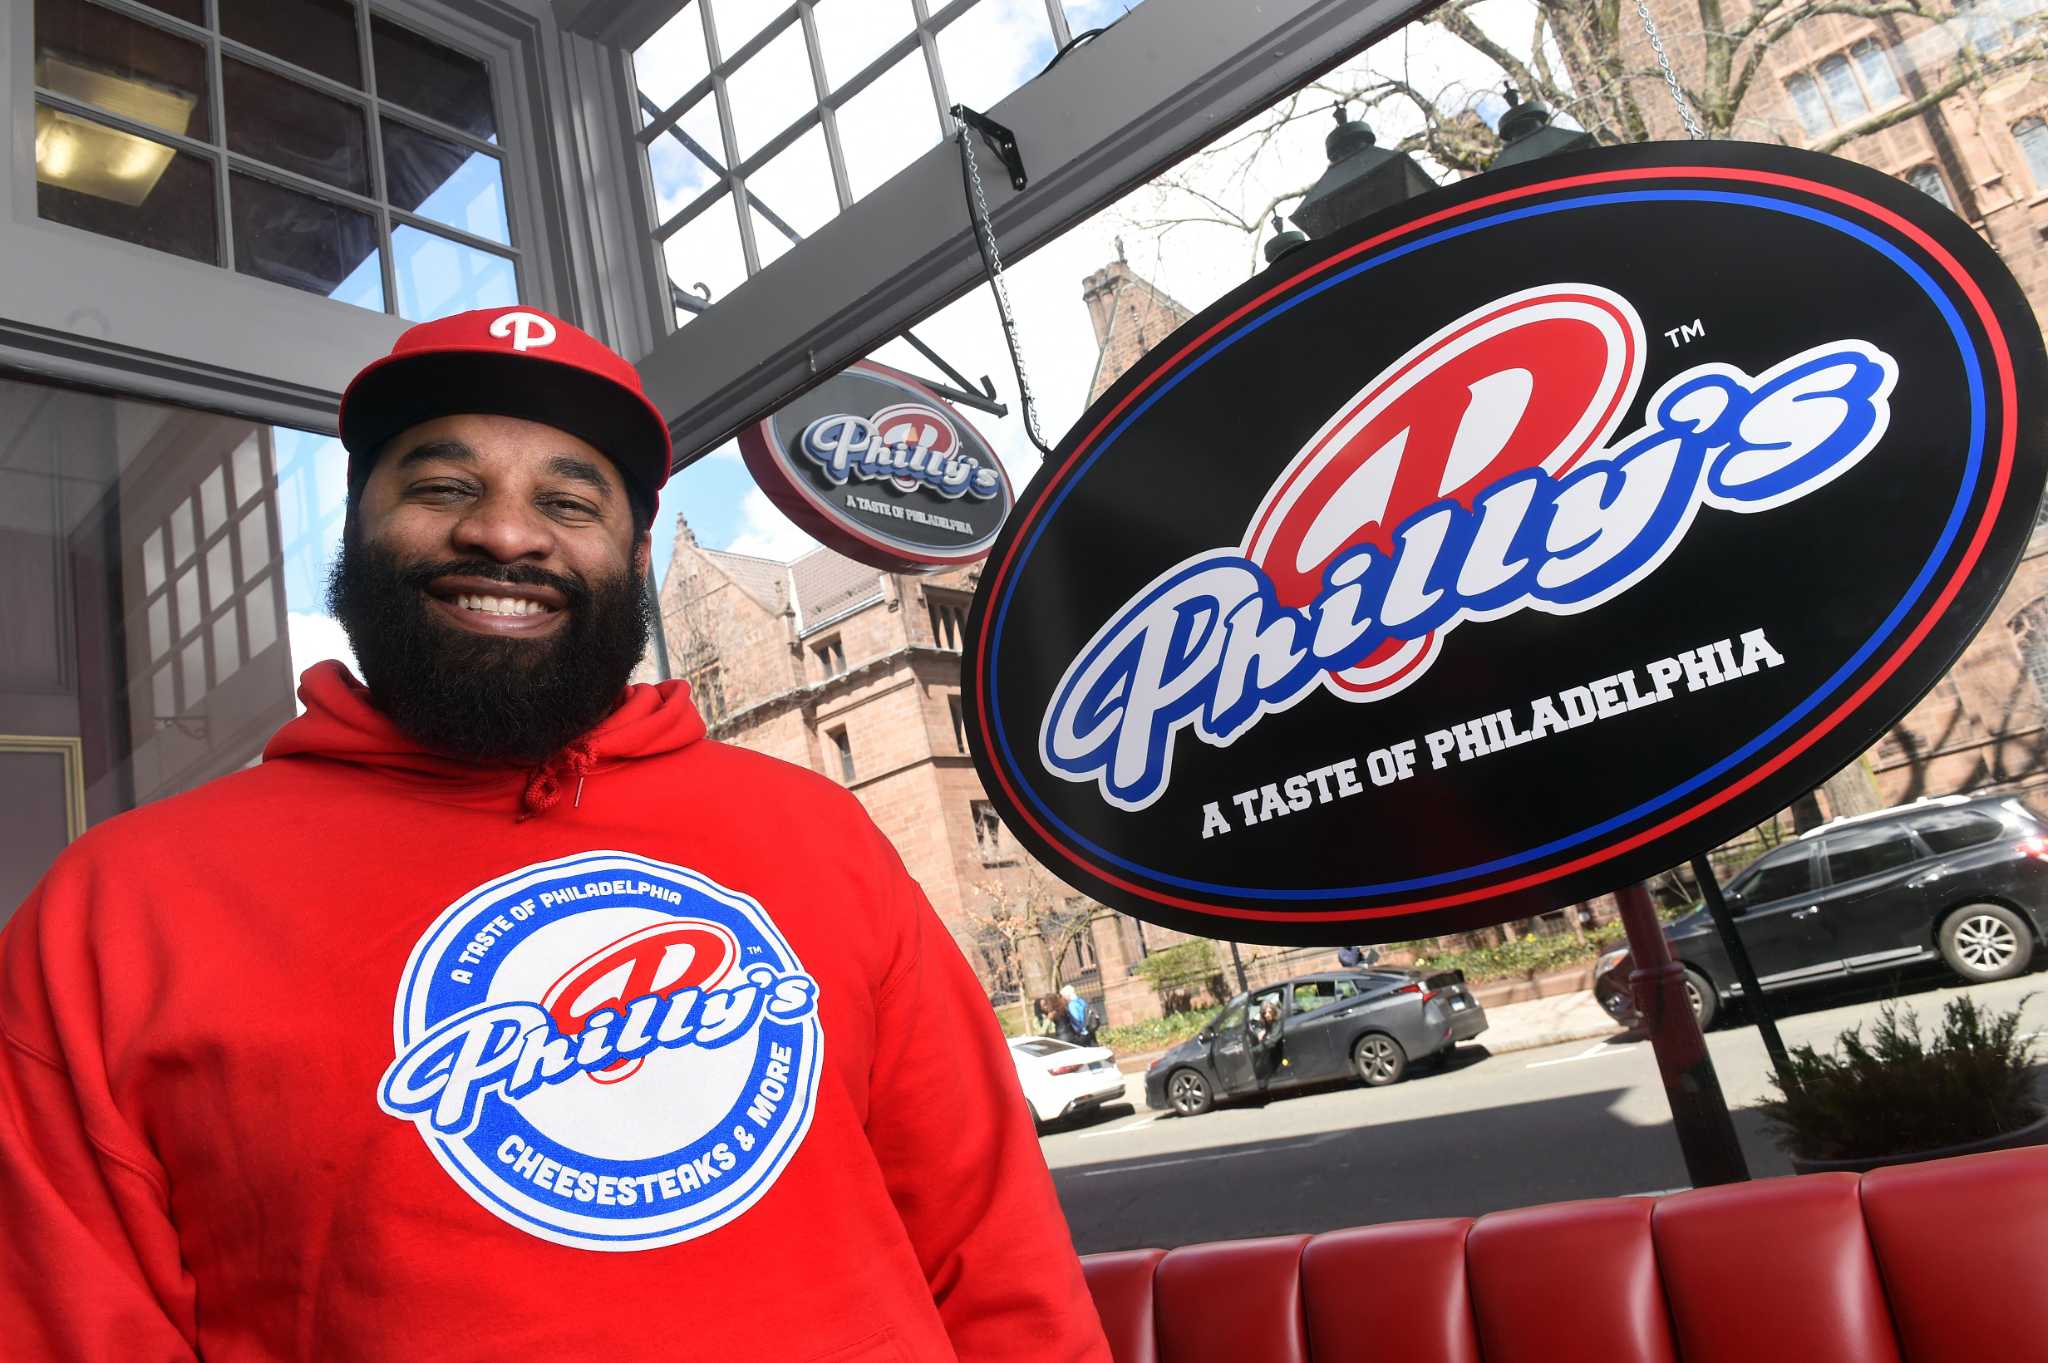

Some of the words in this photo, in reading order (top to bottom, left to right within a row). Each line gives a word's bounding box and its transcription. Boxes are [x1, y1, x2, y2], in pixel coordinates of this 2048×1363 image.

[489, 312, 557, 352] P
[1664, 318, 1706, 348] TM
[804, 414, 1000, 494] Philly's
[846, 494, 857, 508] A
[856, 497, 891, 516] TASTE
[892, 505, 905, 519] OF
[905, 508, 974, 535] PHILADELPHIA
[1045, 352, 1886, 802] Philly's
[1201, 801, 1231, 839] A
[1233, 758, 1363, 826] TASTE
[1366, 739, 1417, 787] OF
[1424, 627, 1785, 770] PHILADELPHIA
[509, 898, 537, 922] OF
[538, 879, 683, 909] PHILADELPHIA
[458, 915, 515, 965] TASTE
[746, 945, 763, 955] TM
[450, 968, 473, 985] A
[384, 970, 814, 1134] Philly's
[496, 1134, 737, 1206] CHEESESTEAKS
[733, 1125, 756, 1151] &
[746, 1041, 793, 1129] MORE
